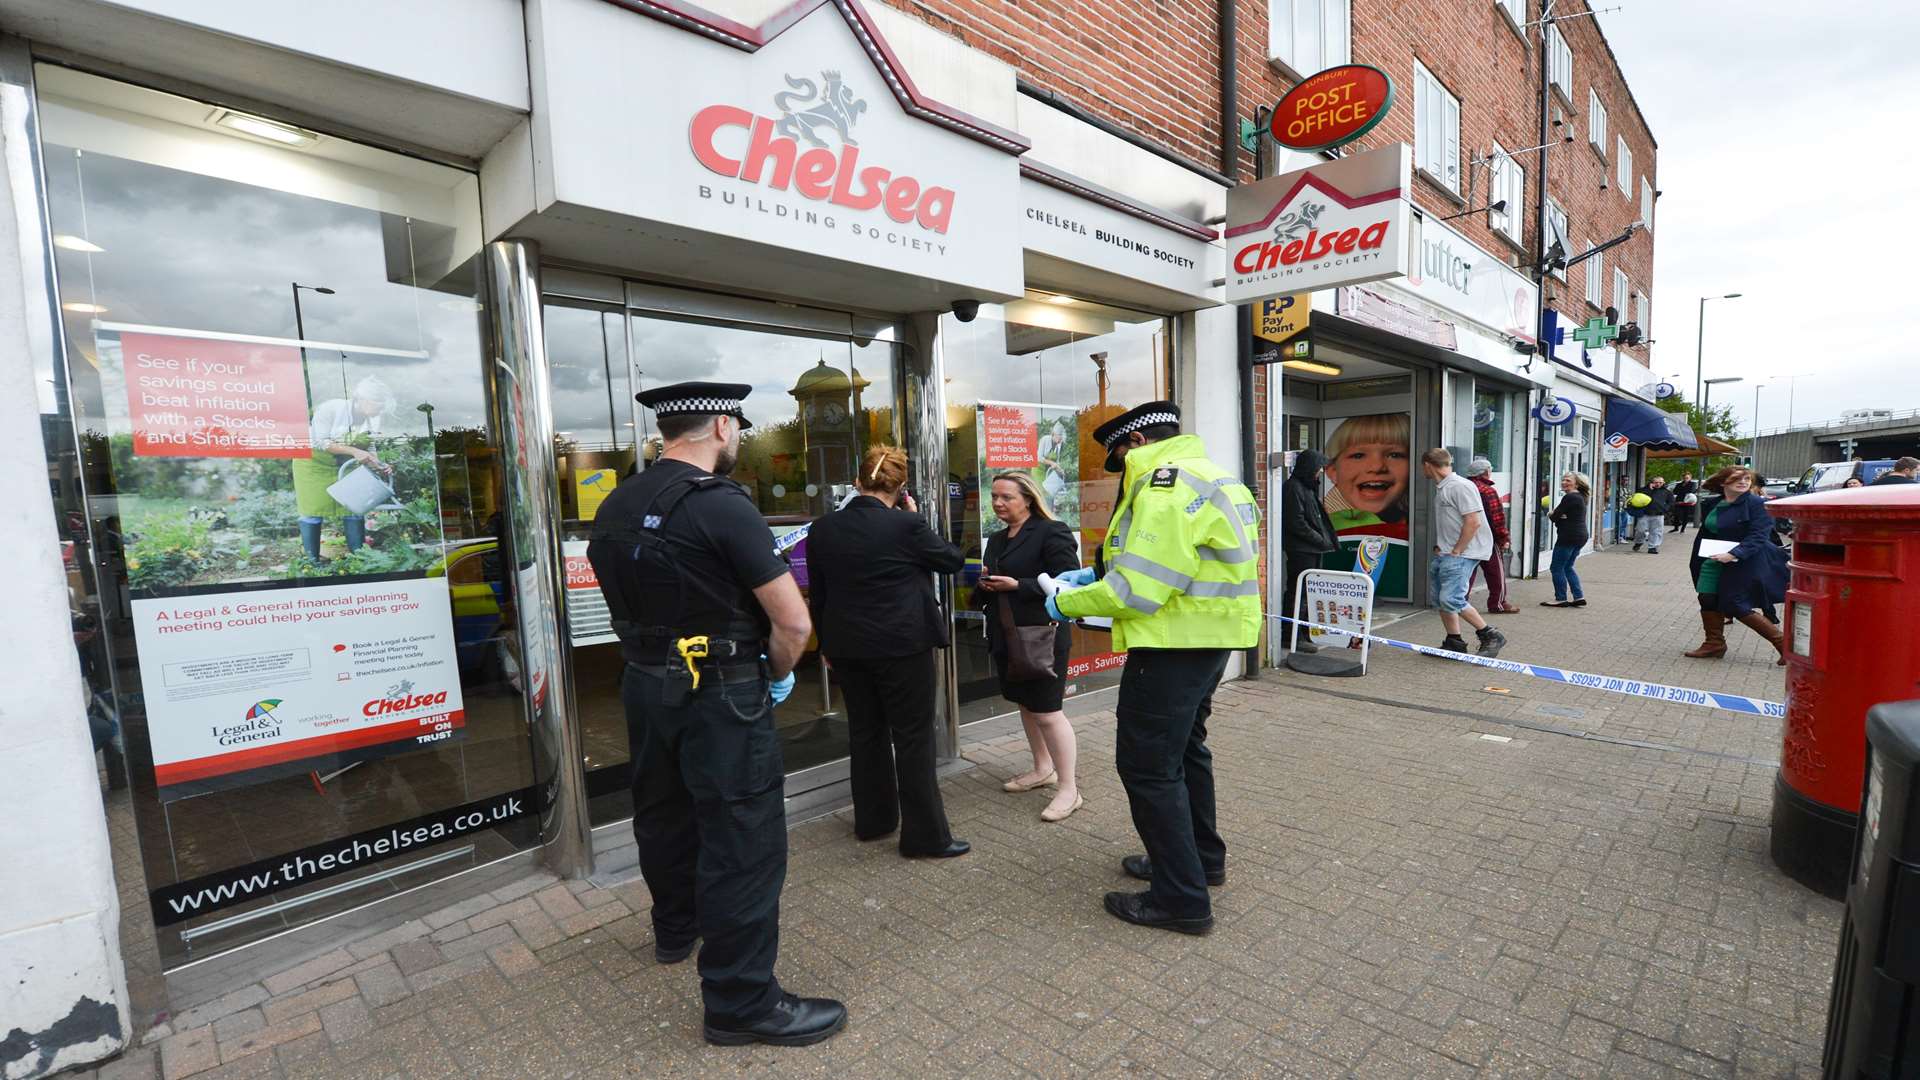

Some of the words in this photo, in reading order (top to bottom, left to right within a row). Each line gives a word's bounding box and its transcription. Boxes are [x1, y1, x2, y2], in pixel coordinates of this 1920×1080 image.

[1305, 70, 1349, 89] SUNBURY
[1296, 82, 1356, 116] POST
[1287, 100, 1367, 138] OFFICE
[689, 104, 956, 235] Chelsea
[698, 185, 836, 229] BUILDING
[852, 223, 948, 256] SOCIETY
[1026, 207, 1087, 236] CHELSEA
[1095, 229, 1150, 256] BUILDING
[1153, 249, 1195, 270] SOCIETY
[1233, 220, 1391, 275] Chelsea
[1237, 267, 1304, 285] BUILDING
[1313, 252, 1381, 270] SOCIETY
[1423, 239, 1472, 296] utter
[1263, 317, 1283, 326] Pay
[1263, 323, 1294, 335] Point
[137, 353, 180, 369] See
[186, 358, 198, 372] if
[203, 361, 246, 376] your
[139, 376, 217, 393] savings
[223, 381, 275, 394] could
[142, 392, 190, 408] beat
[195, 396, 271, 412] inflation
[144, 412, 187, 426] with
[194, 416, 206, 427] a
[212, 414, 275, 429] Stocks
[147, 430, 186, 445] and
[193, 431, 258, 446] Shares
[265, 434, 297, 447] ISA
[950, 485, 961, 496] CE
[566, 560, 593, 573] Ope
[567, 572, 598, 584] hou
[1307, 580, 1368, 590] PHOTOBOOTH
[1319, 588, 1337, 596] THIS
[1339, 590, 1368, 599] STORE
[157, 611, 169, 621] A
[174, 608, 217, 620] Legal
[221, 606, 231, 615] &
[236, 601, 293, 613] General
[298, 596, 352, 608] financial
[357, 591, 408, 604] planning
[158, 620, 222, 634] meeting
[227, 615, 267, 627] could
[272, 611, 302, 623] help
[306, 610, 335, 622] your
[340, 605, 387, 616] savings
[390, 602, 420, 613] grow
[381, 638, 400, 646] Legal
[409, 634, 435, 642] General
[353, 647, 386, 657] Financial
[388, 644, 418, 653] Planning
[354, 657, 385, 665] meeting
[404, 651, 424, 659] today
[1067, 662, 1090, 677] ages
[1095, 653, 1128, 668] Savings
[1569, 673, 1602, 688] CROSS
[1603, 678, 1624, 691] NOT
[1625, 681, 1641, 694] DO
[1642, 683, 1665, 698] LINE
[1668, 687, 1706, 705] POLICE
[363, 691, 448, 717] Chelsea
[1763, 702, 1786, 717] OSS
[212, 720, 255, 737] Legal
[258, 718, 272, 729] &
[314, 717, 350, 728] together
[419, 713, 450, 725] BUILT
[434, 722, 452, 731] ON
[219, 726, 281, 746] General
[416, 730, 453, 743] TRUST
[168, 797, 523, 914] www.thechelsea.co.uk
